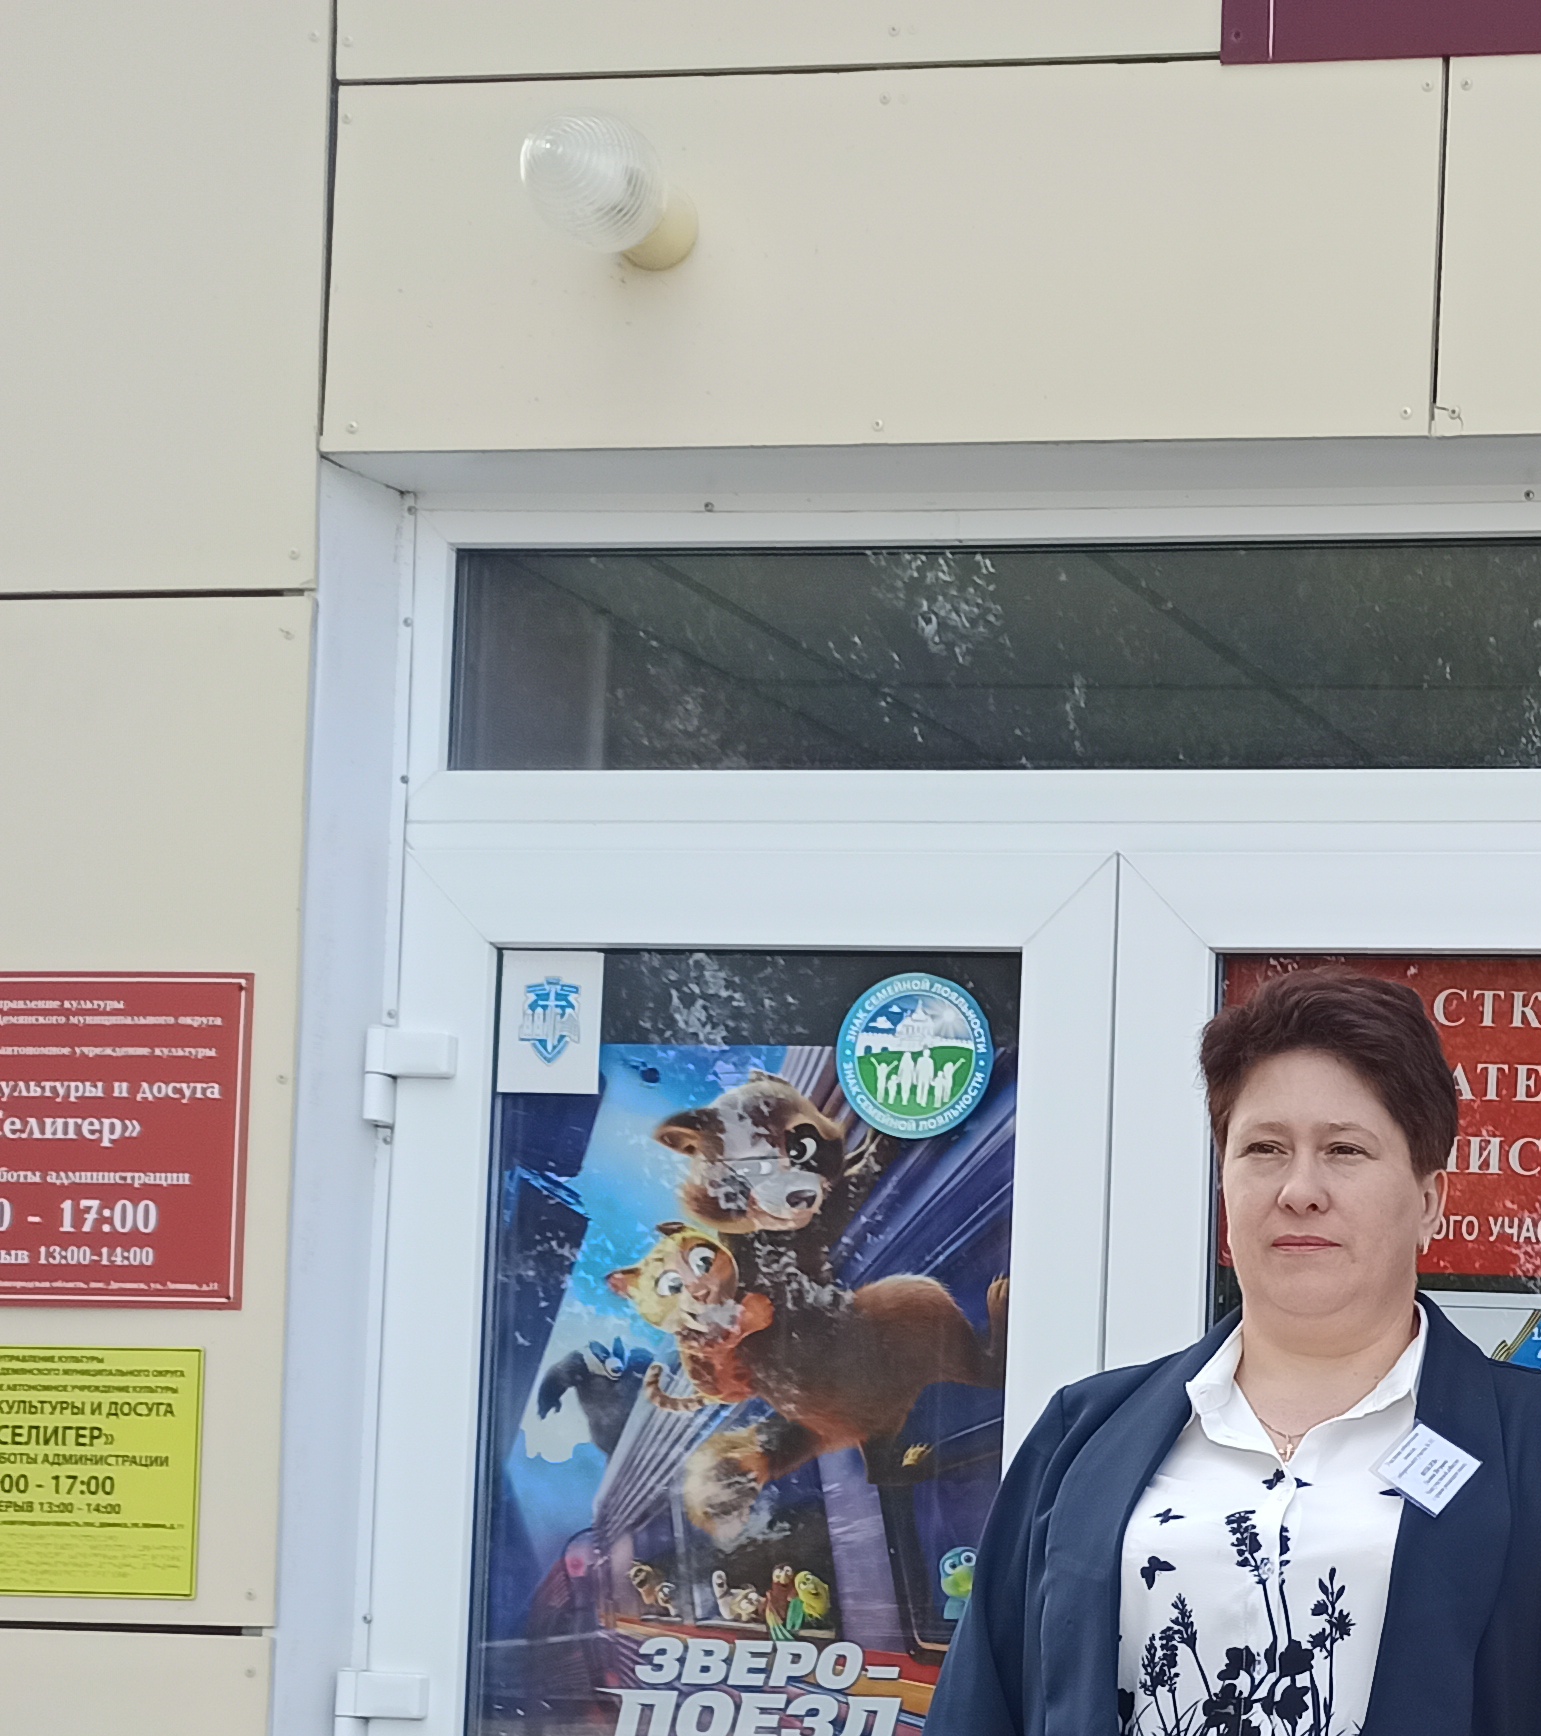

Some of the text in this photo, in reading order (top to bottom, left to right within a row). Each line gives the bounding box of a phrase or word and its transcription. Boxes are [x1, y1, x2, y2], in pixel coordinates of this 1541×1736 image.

[846, 978, 988, 1054] ЗНАК СЕМЕЙНОЙ ЛОЯЛЬНОСТИ
[0, 1080, 222, 1104] ультуры и досуга
[843, 1062, 986, 1131] ЗНАК СЕМЕЙНОЙ ЛОЯЛЬНОСТИ
[47, 1170, 191, 1188] администрации
[60, 1199, 158, 1234] 17:00
[39, 1246, 155, 1267] 13:00-14:00
[90, 1401, 103, 1417] И
[106, 1401, 176, 1420] ДОСУГА
[41, 1453, 170, 1469] АДМИНИСТРАЦИИ
[51, 1474, 116, 1496] 17:00
[39, 1501, 75, 1514] 13:00
[86, 1503, 122, 1515] 14:00
[634, 1636, 900, 1691] ЗВЕРО-
